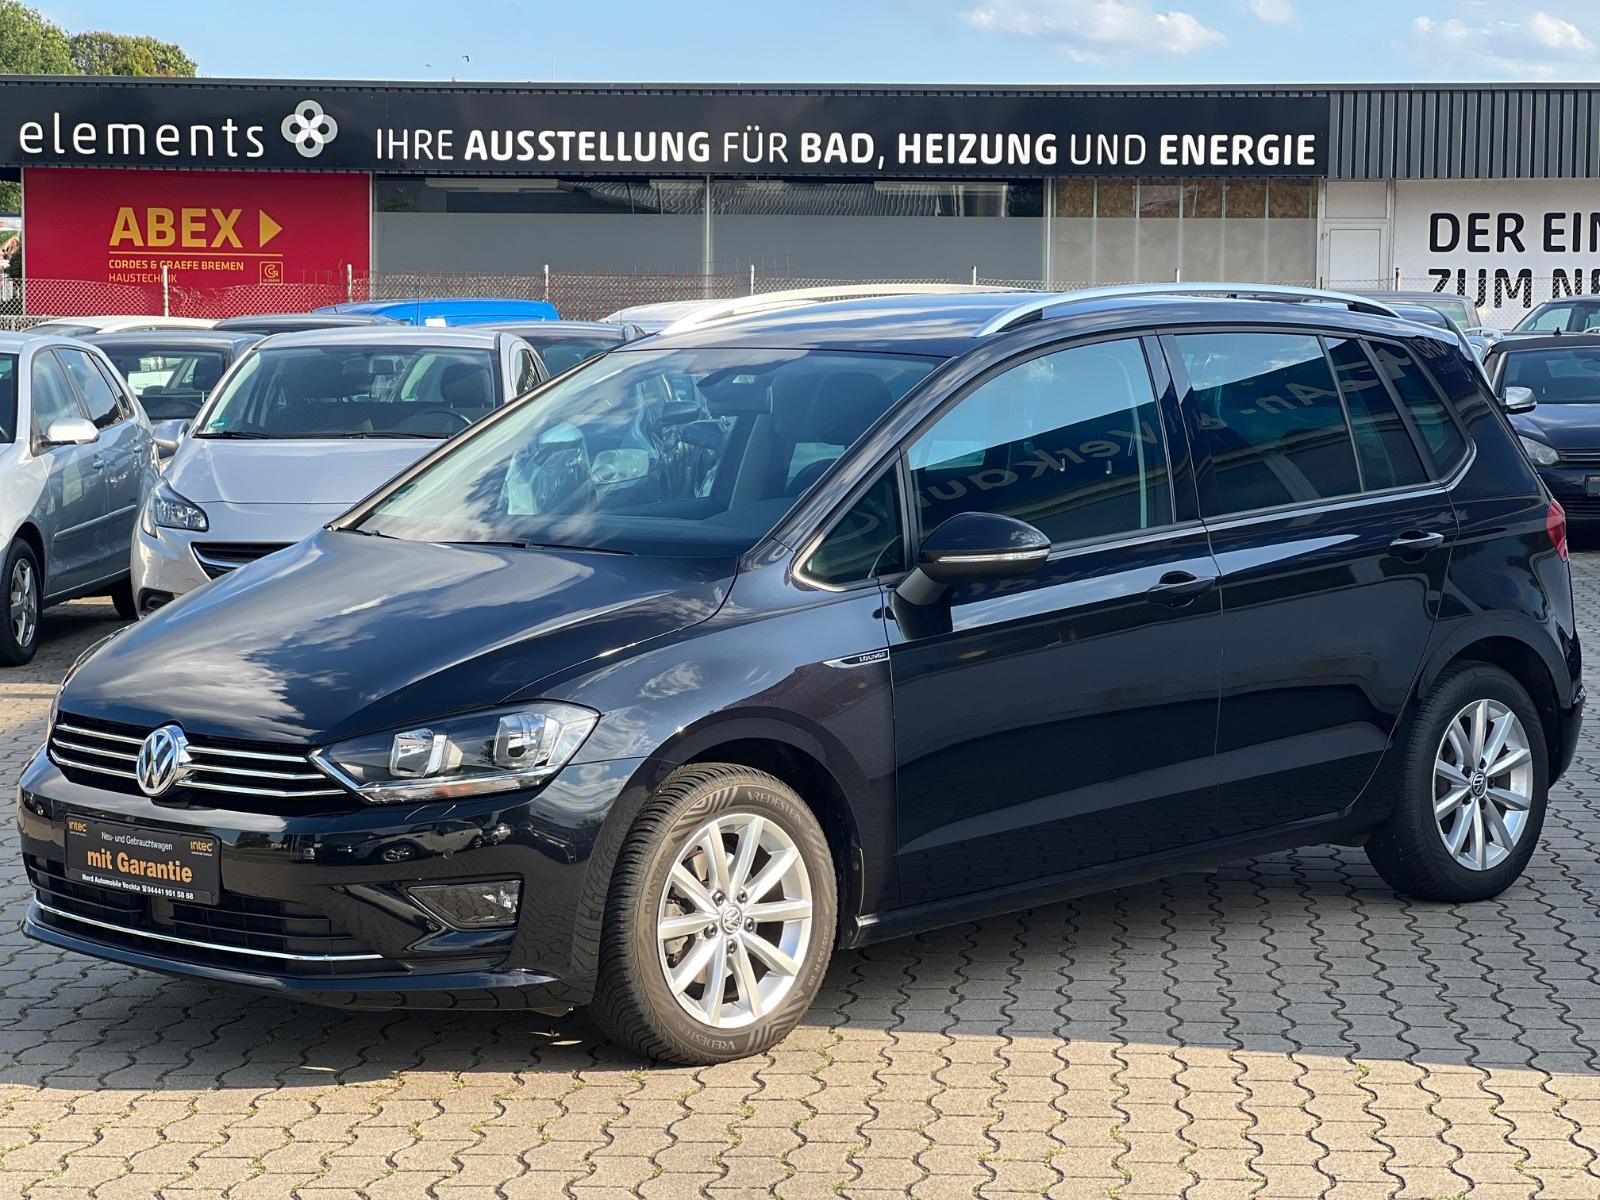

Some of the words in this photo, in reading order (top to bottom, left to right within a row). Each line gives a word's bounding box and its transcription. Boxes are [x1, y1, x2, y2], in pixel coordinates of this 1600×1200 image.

[19, 112, 265, 158] elements
[376, 128, 454, 161] IHRE
[464, 130, 710, 163] AUSSTELLUNG
[723, 125, 789, 164] FÜR
[801, 132, 884, 170] BAD,
[898, 133, 1057, 165] HEIZUNG
[1070, 134, 1146, 165] UND
[1160, 134, 1316, 166] ENERGIE
[109, 207, 243, 248] ABEX
[1429, 212, 1526, 253] DER
[109, 259, 148, 270] CORDES
[150, 260, 158, 270] &
[202, 261, 244, 271] BREMEN
[109, 273, 178, 284] HAUSTECHIK
[1428, 268, 1533, 309] ZUM
[68, 821, 88, 833] intec
[115, 834, 126, 844] und
[126, 835, 173, 852] Gebrauchtwagen
[190, 840, 213, 852] intec
[87, 848, 113, 870] mit
[116, 851, 193, 883] Garantie
[95, 876, 122, 888] Automobile
